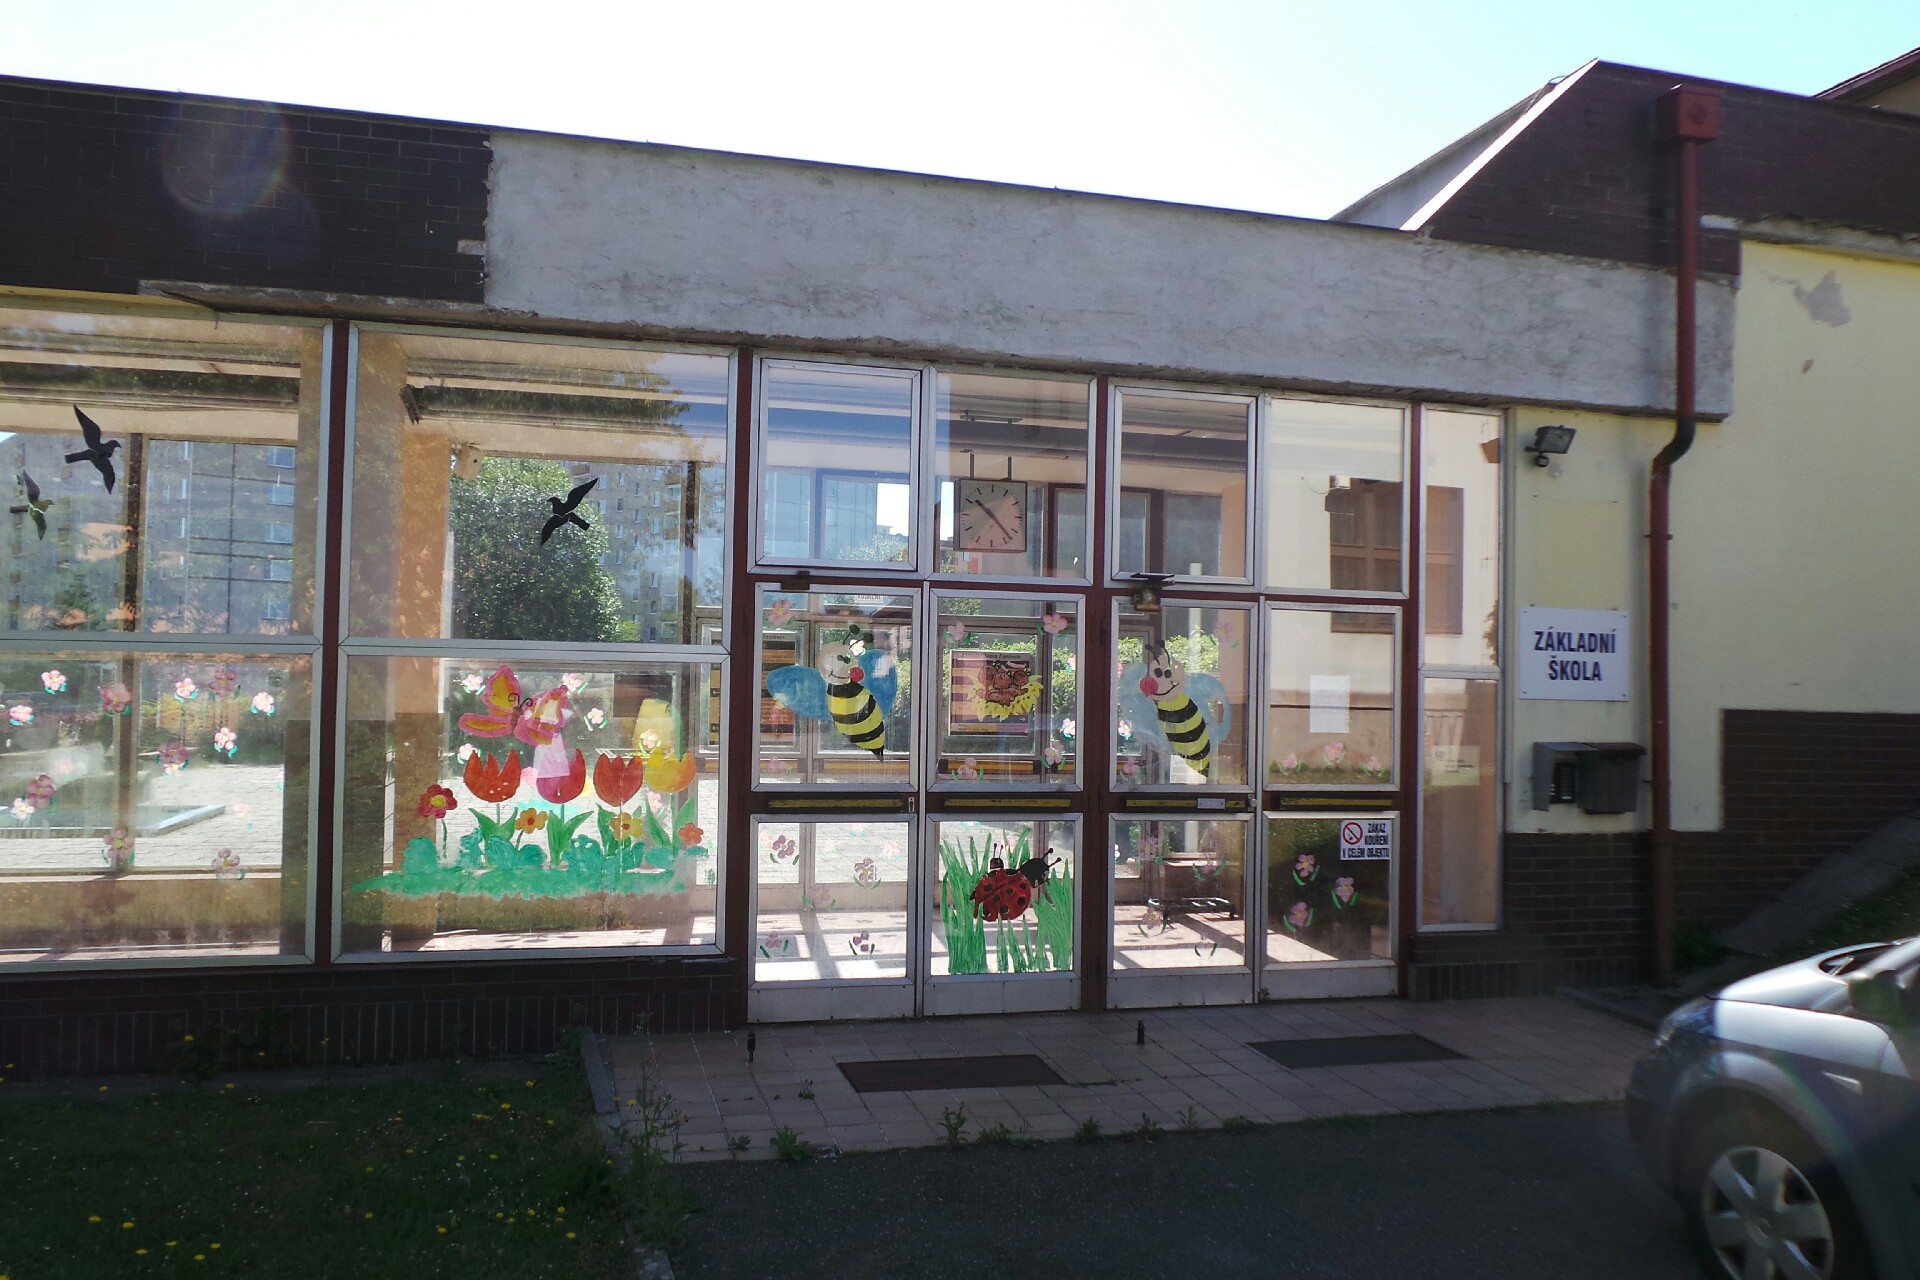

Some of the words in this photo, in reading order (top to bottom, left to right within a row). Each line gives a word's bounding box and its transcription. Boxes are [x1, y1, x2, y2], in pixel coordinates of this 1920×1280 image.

[1534, 626, 1616, 653] ZÁKLADNÍ
[1548, 655, 1602, 681] ŠKOLA
[1368, 821, 1386, 833] ZÁKAZ
[1342, 847, 1347, 858] V
[1348, 846, 1366, 858] CELÉM
[1367, 847, 1390, 858] OBJEKTU
